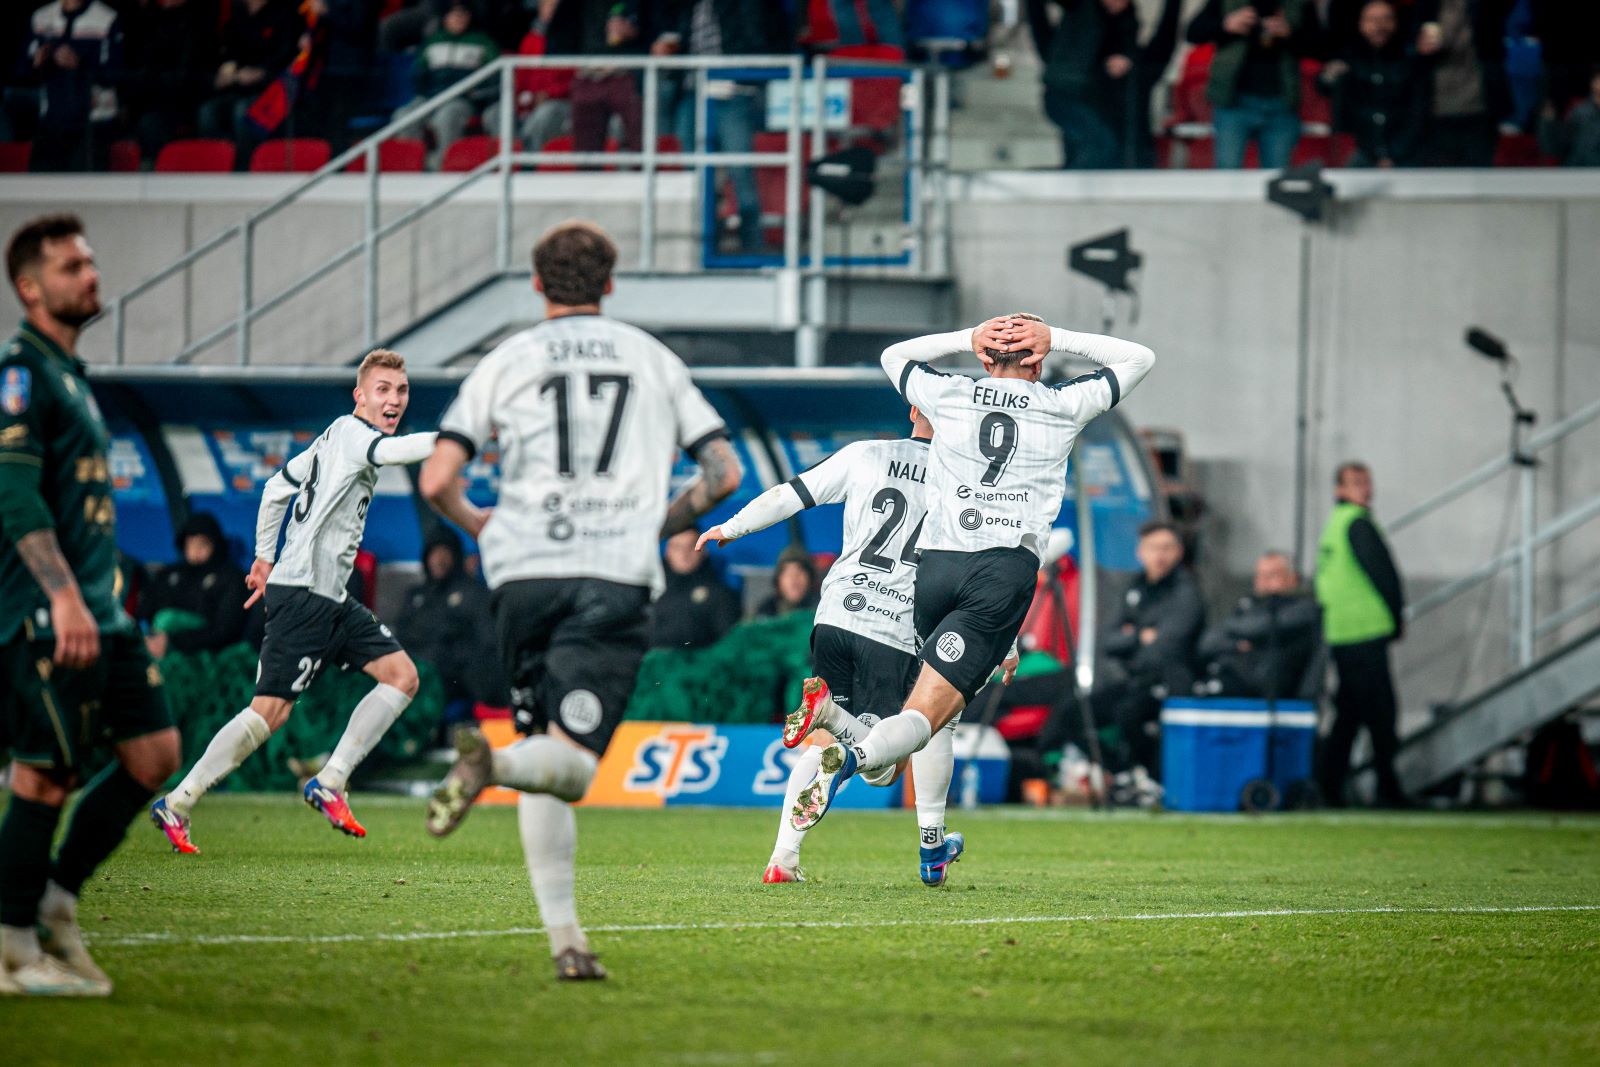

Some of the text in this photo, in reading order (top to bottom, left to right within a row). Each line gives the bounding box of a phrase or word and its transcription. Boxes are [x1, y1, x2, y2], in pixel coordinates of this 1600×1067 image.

[973, 386, 1030, 409] FELIKS
[540, 374, 634, 478] 17
[979, 411, 1018, 487] 9
[974, 491, 1029, 503] elemont
[985, 517, 1022, 529] OPOLE
[867, 605, 902, 622] OPOLE
[938, 633, 960, 661] ifm
[626, 727, 726, 794] STS
